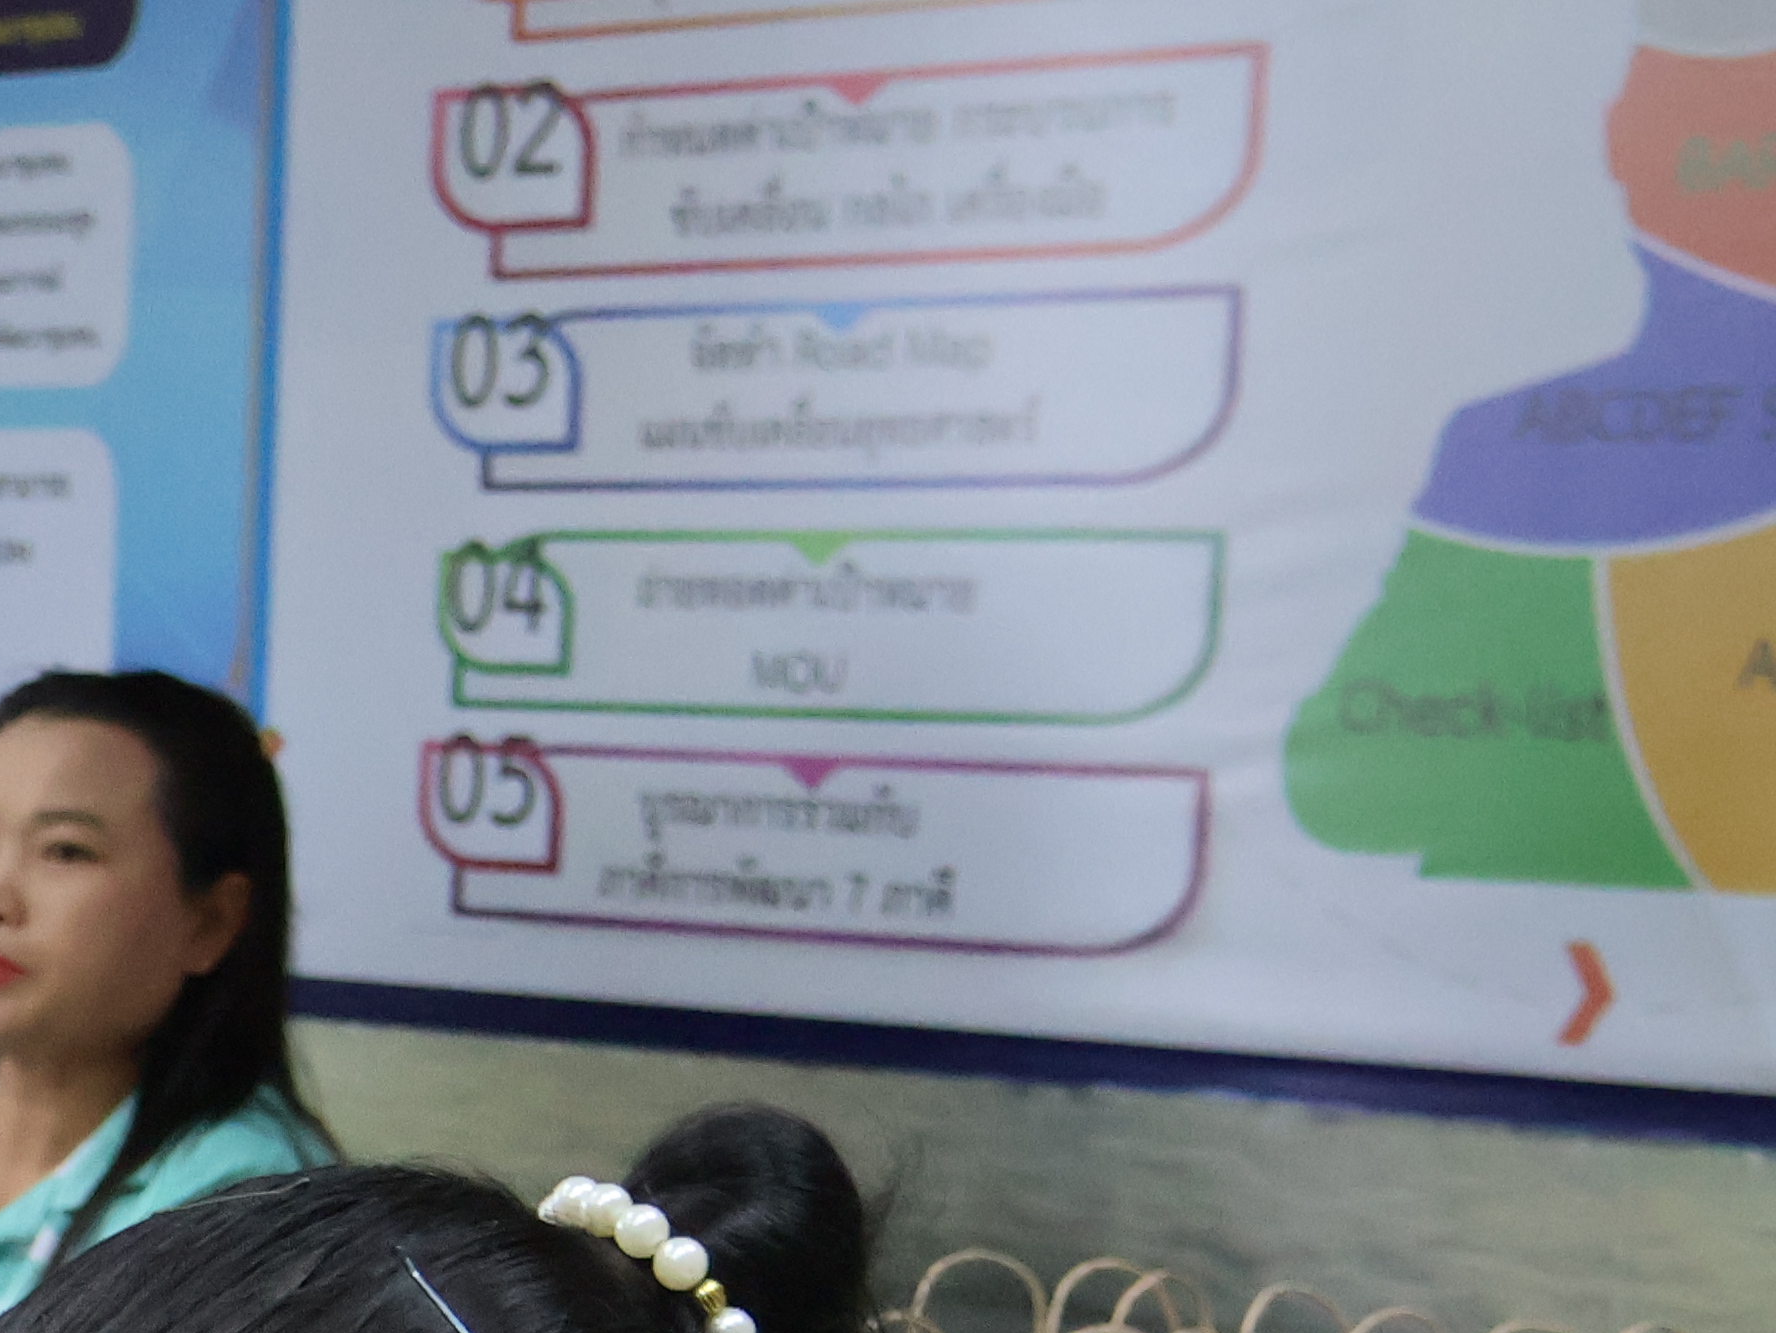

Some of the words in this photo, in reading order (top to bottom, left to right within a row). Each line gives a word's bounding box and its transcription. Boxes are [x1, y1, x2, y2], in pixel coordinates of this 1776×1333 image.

[459, 80, 564, 179] 02
[450, 314, 551, 407] 03
[446, 541, 547, 634] 04
[437, 733, 536, 826] 05
